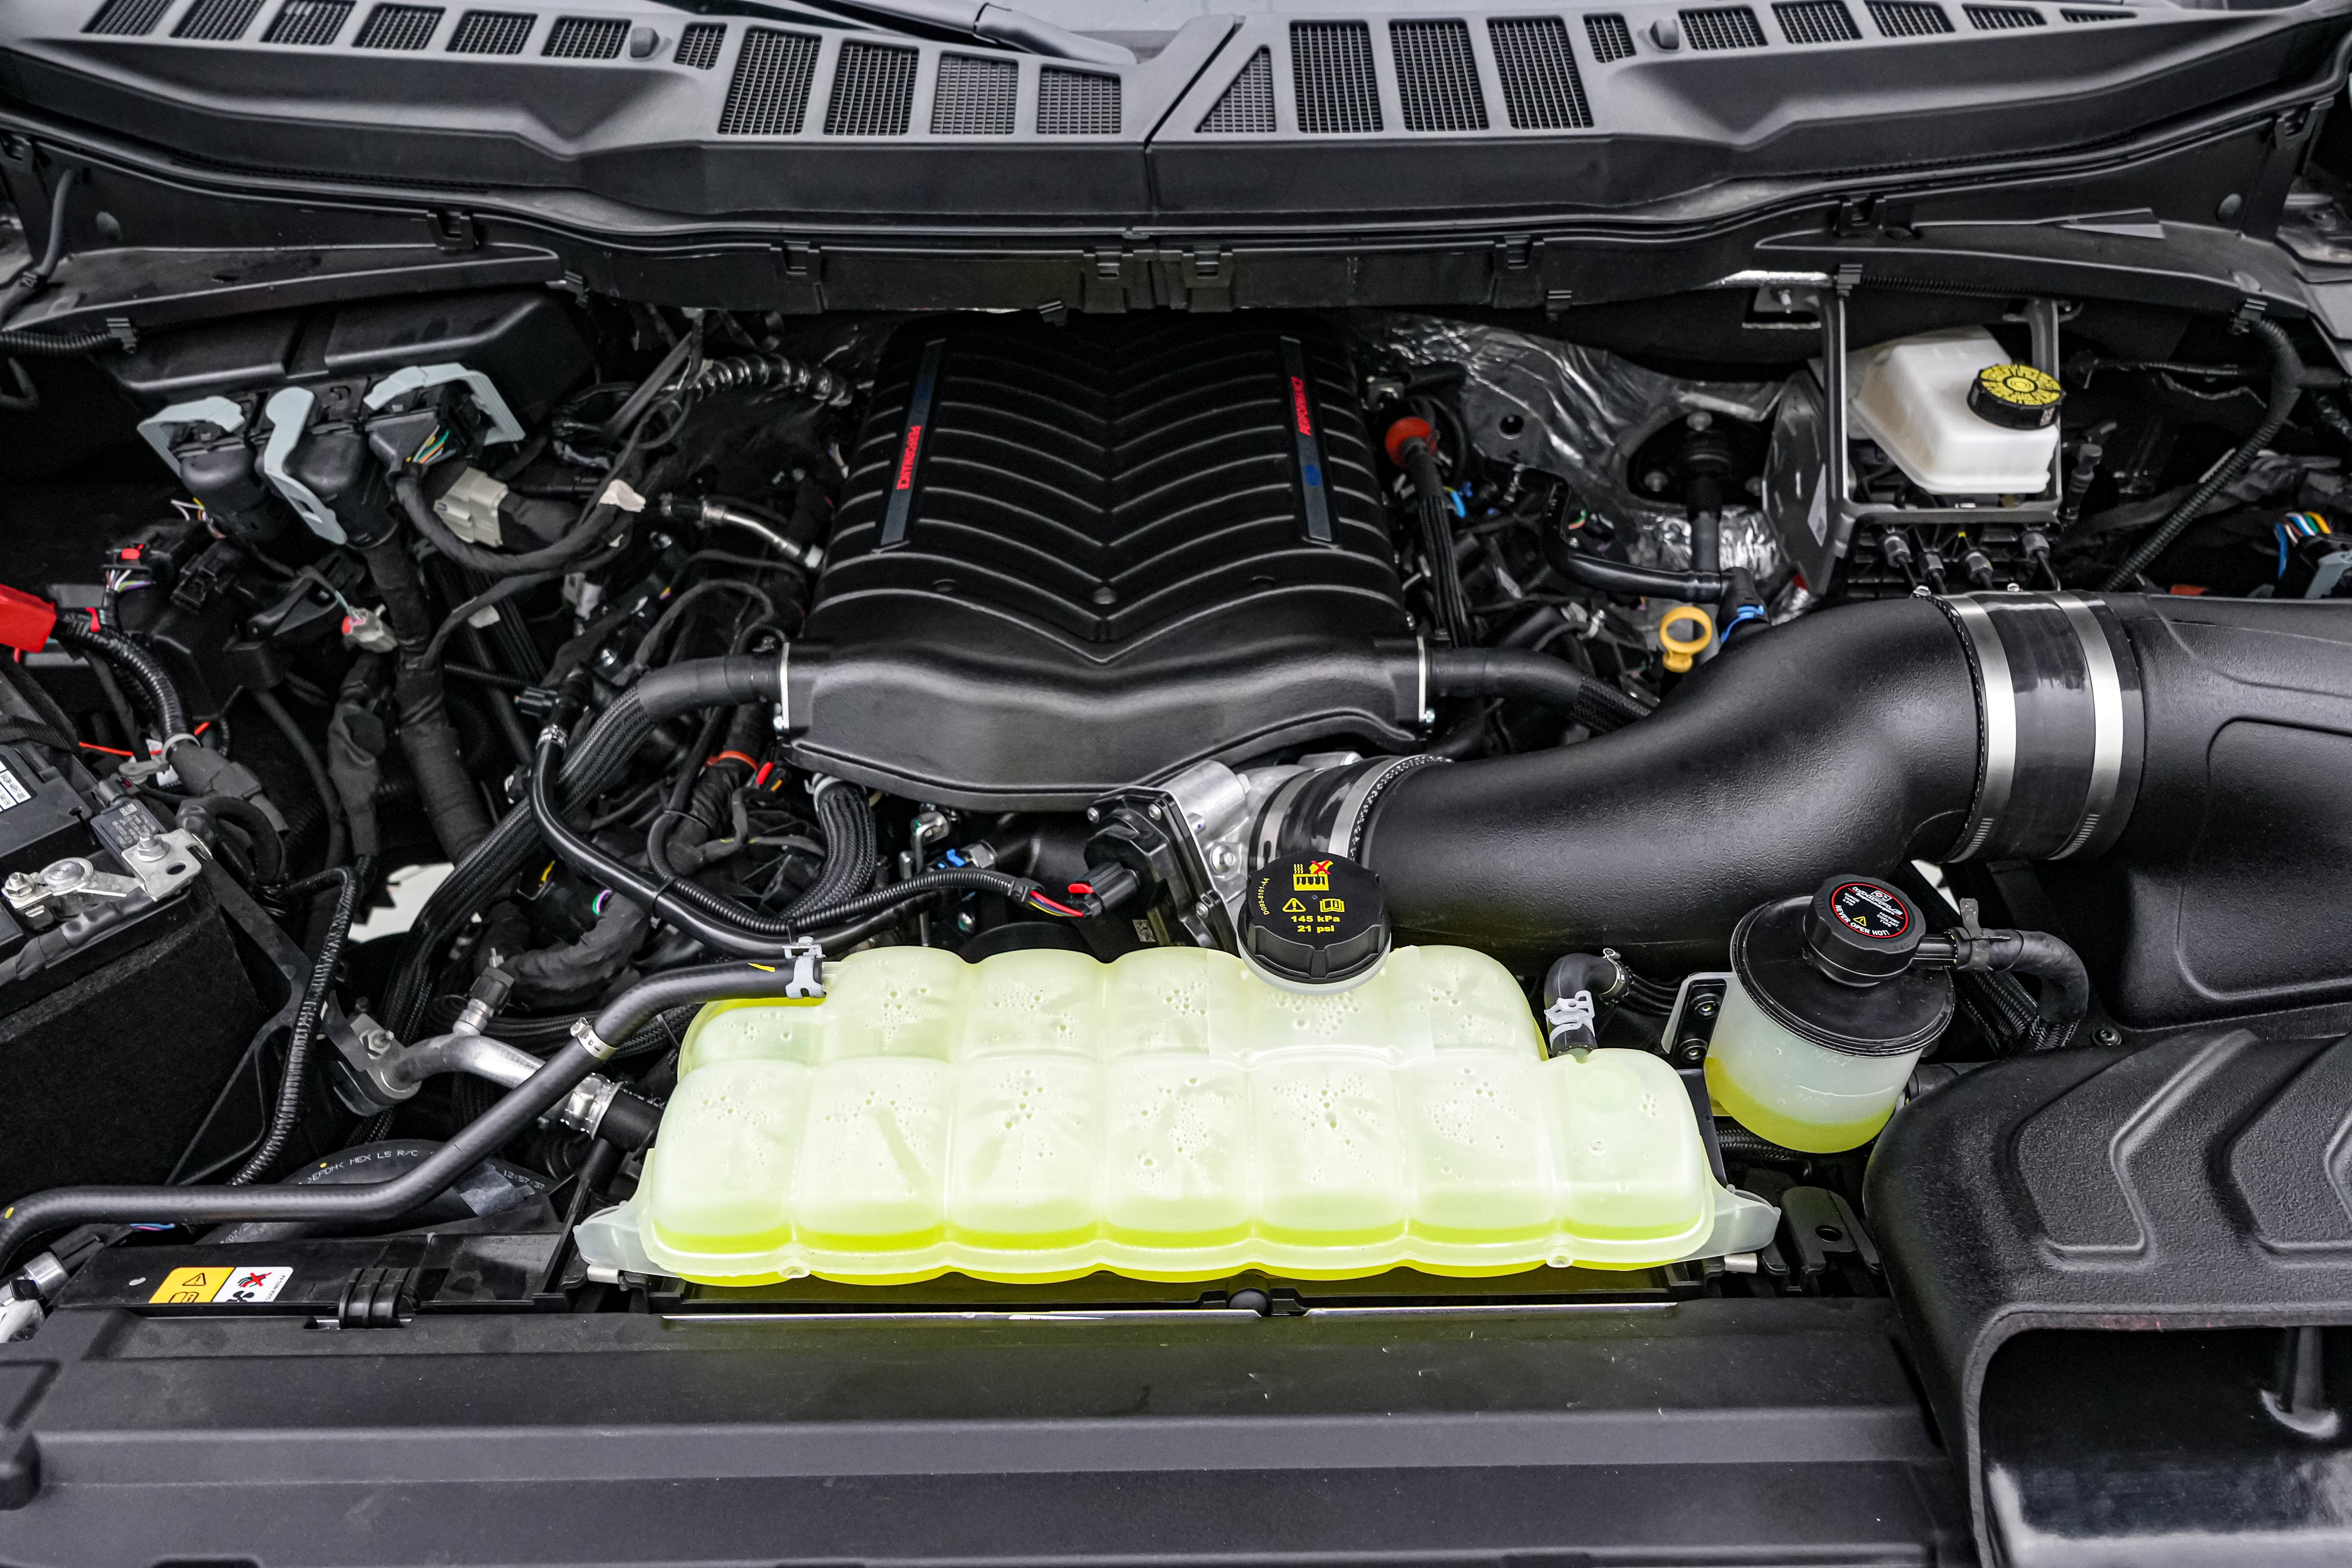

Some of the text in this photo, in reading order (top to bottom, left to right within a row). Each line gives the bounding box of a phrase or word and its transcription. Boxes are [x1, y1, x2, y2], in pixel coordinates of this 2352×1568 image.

[1258, 878, 1270, 915] DG93-8101-AA
[1844, 893, 1860, 902] SURGE
[1844, 896, 1856, 904] TANK
[1852, 886, 1903, 915] WHIPPLE
[1835, 904, 1851, 923] NEVER
[1850, 922, 1870, 934] OPEN
[1877, 914, 1899, 927] COOLANT
[1879, 912, 1900, 924] FACTORY
[1880, 919, 1892, 927] TYPE
[1316, 925, 1334, 933] psi
